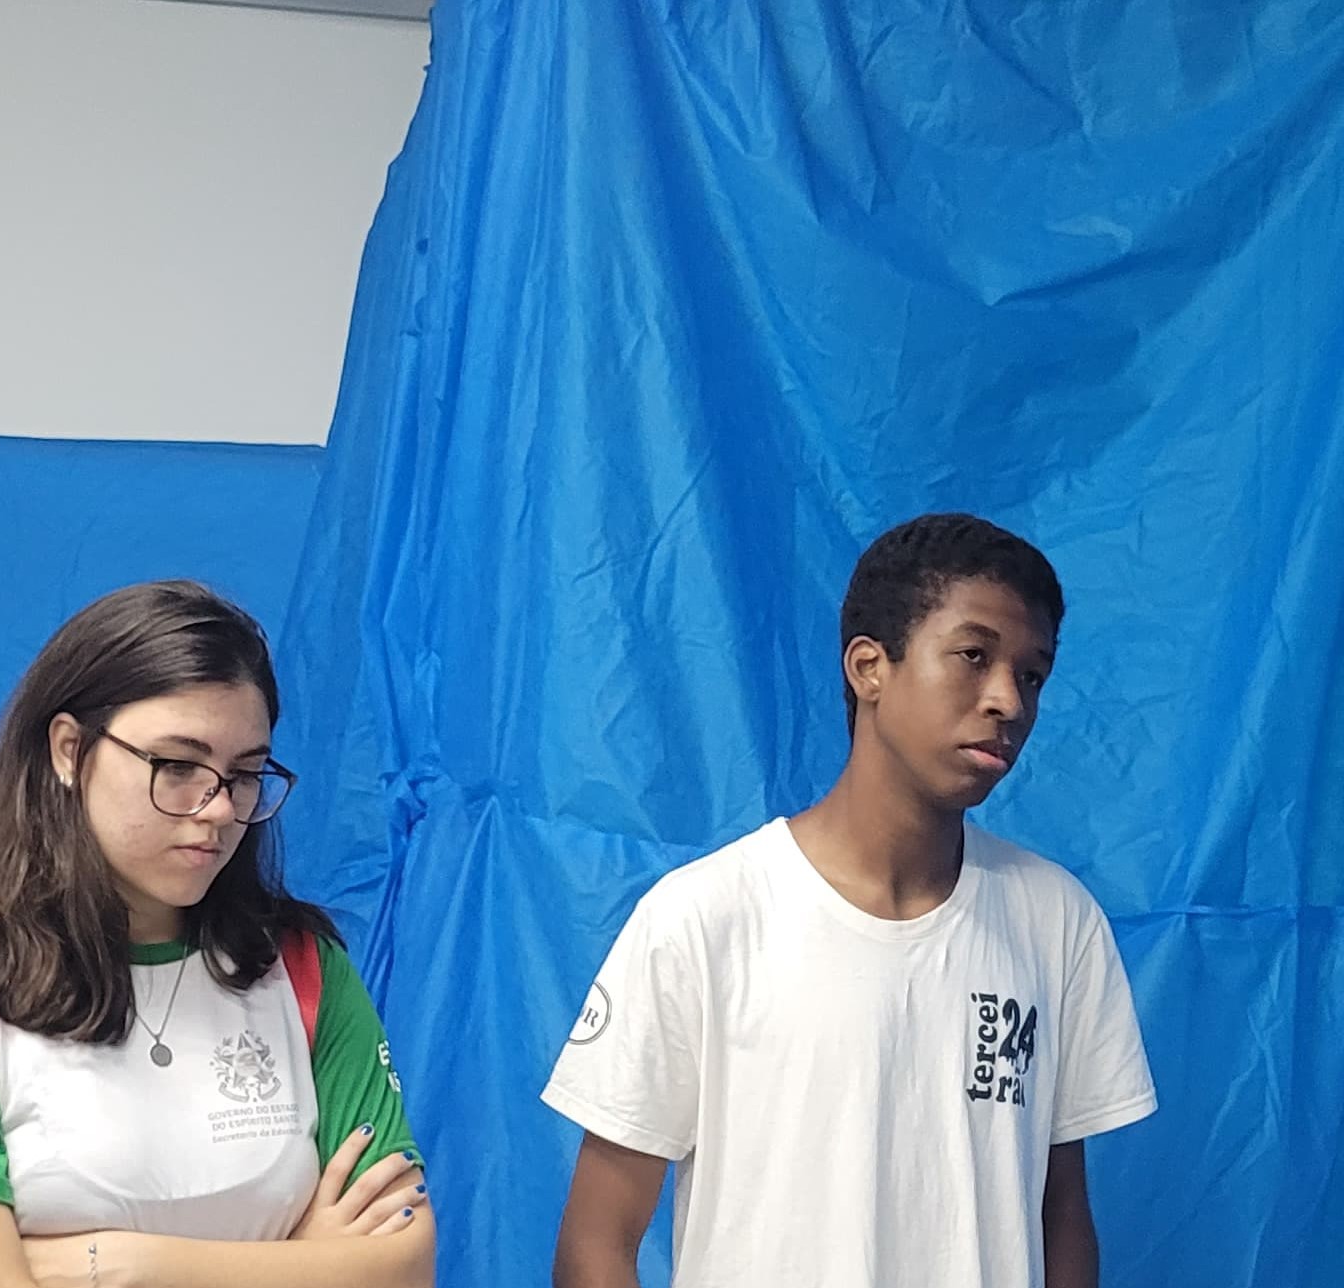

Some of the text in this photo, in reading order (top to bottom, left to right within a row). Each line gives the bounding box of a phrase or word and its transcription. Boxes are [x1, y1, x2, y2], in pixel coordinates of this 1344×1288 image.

[581, 1006, 599, 1028] R
[965, 992, 998, 1102] tercei
[998, 998, 1037, 1075] 24
